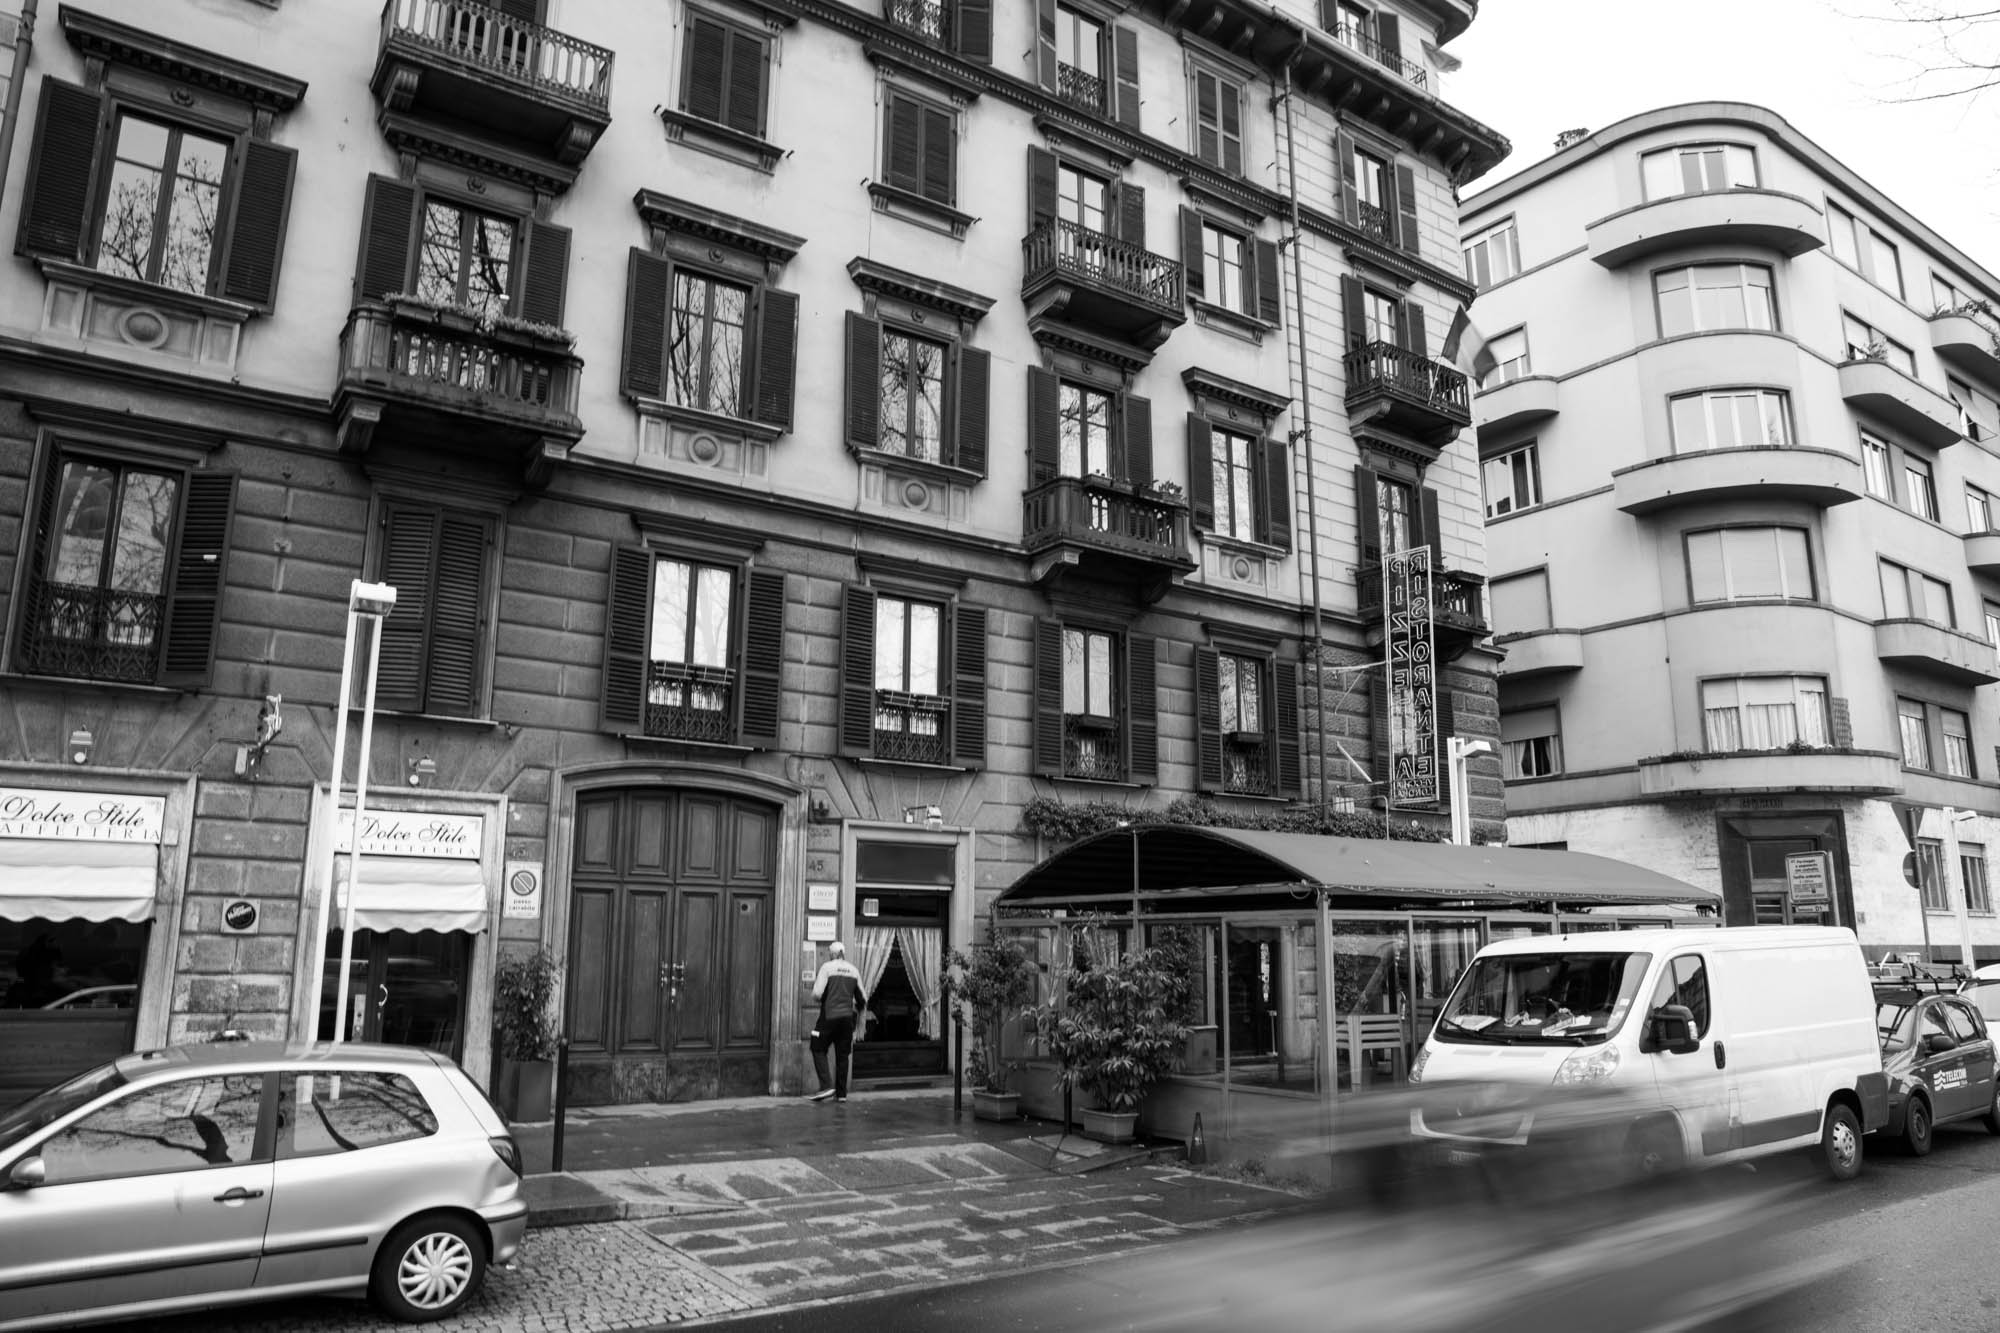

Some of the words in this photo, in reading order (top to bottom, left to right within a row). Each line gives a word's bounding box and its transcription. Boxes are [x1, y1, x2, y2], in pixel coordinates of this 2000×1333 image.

[0, 794, 75, 823] Dolce
[84, 800, 145, 827] Stile
[0, 823, 161, 841] AFFETTERIA
[361, 816, 411, 840] Dolce
[418, 820, 467, 844] Stile
[808, 859, 824, 872] 45
